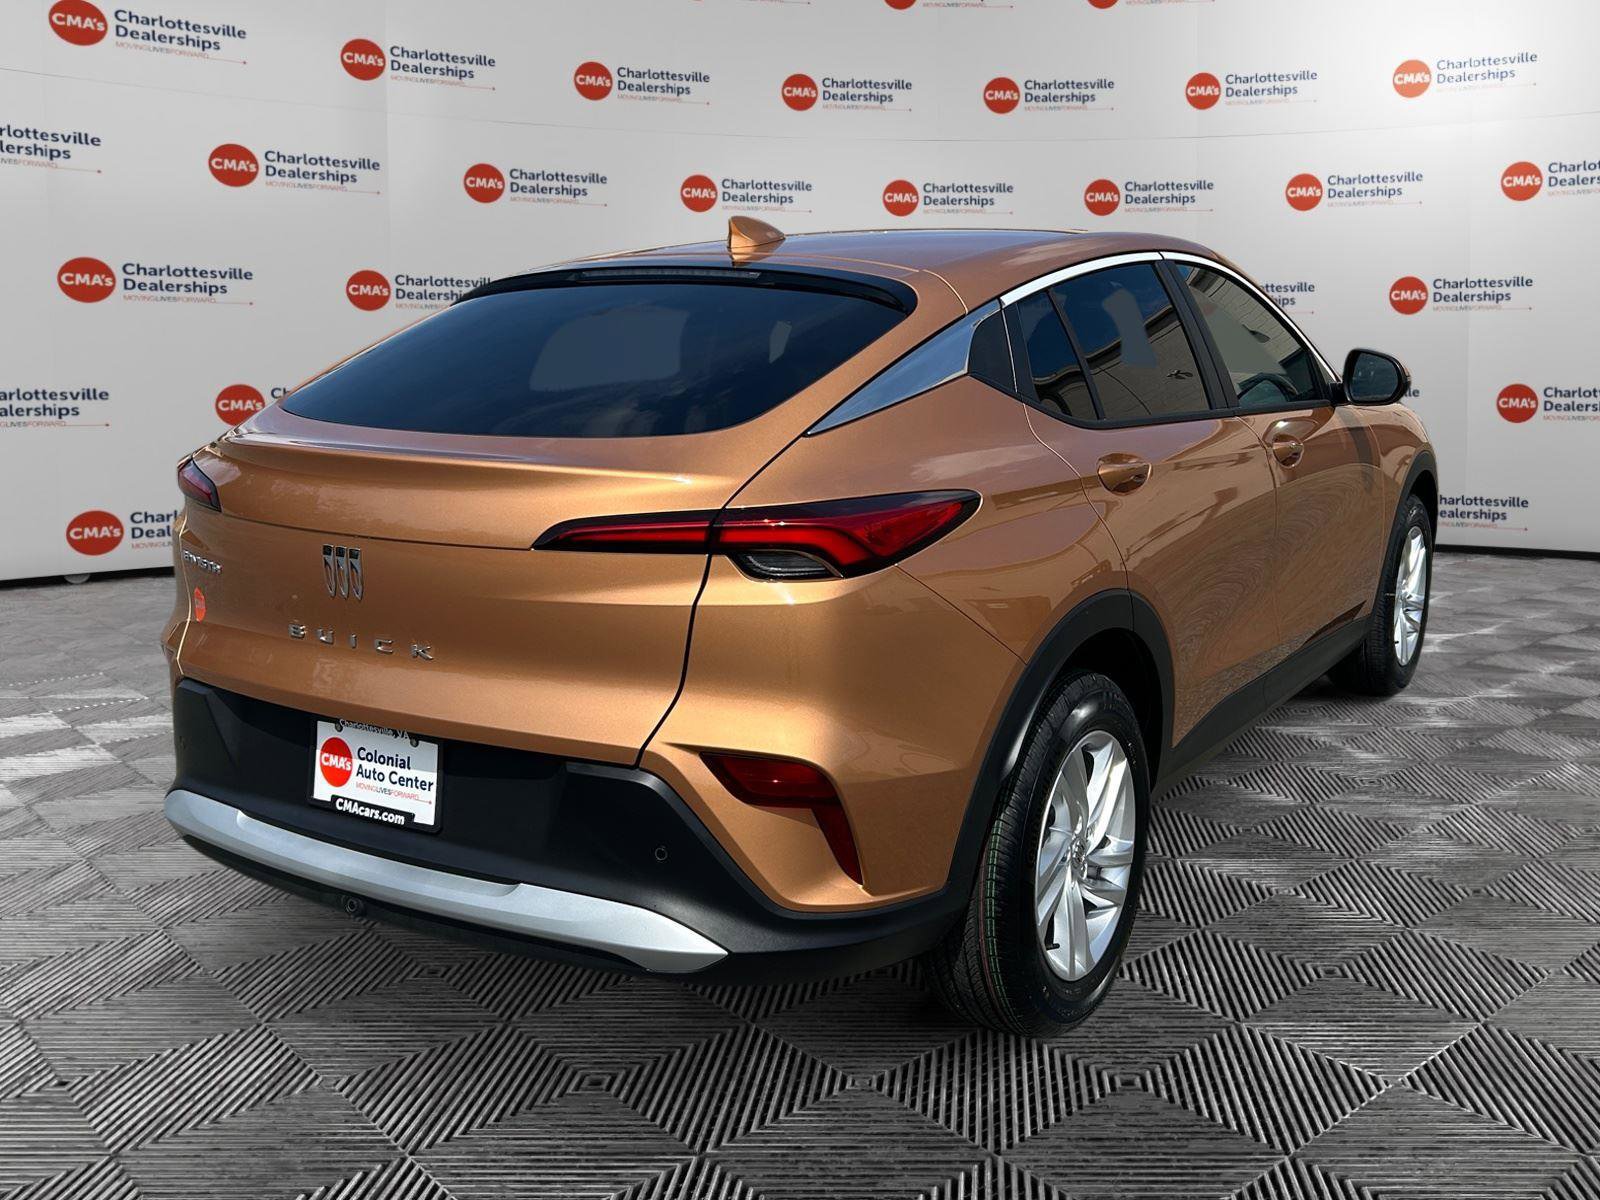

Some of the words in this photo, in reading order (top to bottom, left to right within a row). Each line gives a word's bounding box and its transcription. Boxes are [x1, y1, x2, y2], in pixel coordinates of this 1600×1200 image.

[52, 12, 105, 32] CMA's
[114, 9, 247, 39] Charlottesville
[115, 25, 221, 51] Dealerships
[342, 52, 385, 67] CMA's
[390, 46, 496, 67] Charlottesville
[1436, 52, 1538, 71] Charlottesville
[390, 60, 475, 80] Dealerships
[617, 67, 710, 83] Charlottesville
[1225, 70, 1318, 85] Charlottesville
[1437, 67, 1516, 85] Dealerships
[575, 75, 612, 88] CMA's
[822, 78, 913, 91] Charlottesville
[1024, 79, 1115, 91] Charlottesville
[1394, 72, 1431, 86] CMA's
[617, 80, 691, 96] Dealerships
[783, 87, 817, 98] CMA's
[985, 90, 1018, 101] CMA's
[1186, 85, 1220, 97] CMA's
[1225, 84, 1298, 99] Dealerships
[822, 90, 894, 104] Dealerships
[1024, 91, 1096, 105] Dealerships
[0, 124, 101, 146] rlottesville
[0, 140, 71, 160] lerships
[210, 157, 257, 173] CMA's
[264, 150, 381, 172] Charlottesville
[265, 164, 358, 184] Dealerships
[509, 168, 608, 185] Charlottesville
[1327, 170, 1423, 186] Charlottesville
[1503, 175, 1541, 187] CMA's
[465, 176, 503, 190] CMA's
[509, 182, 588, 198] Dealerships
[721, 178, 812, 192] Charlottesville
[923, 182, 1014, 194] Charlottesville
[1124, 180, 1214, 193] Charlottesville
[682, 187, 716, 199] CMA's
[721, 191, 794, 206] Dealerships
[884, 192, 918, 203] CMA's
[1085, 191, 1119, 203] CMA's
[1124, 192, 1196, 206] Dealerships
[1287, 186, 1321, 199] CMA's
[1327, 185, 1403, 200] Dealerships
[923, 194, 995, 208] Dealerships
[122, 263, 254, 281] Charlottesville
[60, 272, 114, 288] CMA's
[123, 278, 228, 296] Dealerships
[395, 274, 491, 288] Charlottesvill
[1433, 276, 1533, 290] Charlottesville
[348, 284, 389, 297] CMA's
[1391, 290, 1426, 301] CMA's
[1433, 290, 1512, 304] Dealerships
[0, 388, 109, 401] arlottesville
[218, 399, 263, 411] CMA's
[1498, 397, 1537, 409] CMA's
[0, 404, 80, 420] alerships
[1439, 494, 1529, 508] harlottesville
[1439, 508, 1507, 522] ealerships
[69, 526, 122, 541] CMA's
[288, 623, 434, 661] BUICK
[321, 752, 352, 772] CMA's
[357, 746, 412, 770] Colonial
[356, 763, 385, 782] Auto
[388, 770, 434, 792] Center
[335, 797, 405, 825] CMAcars.com
